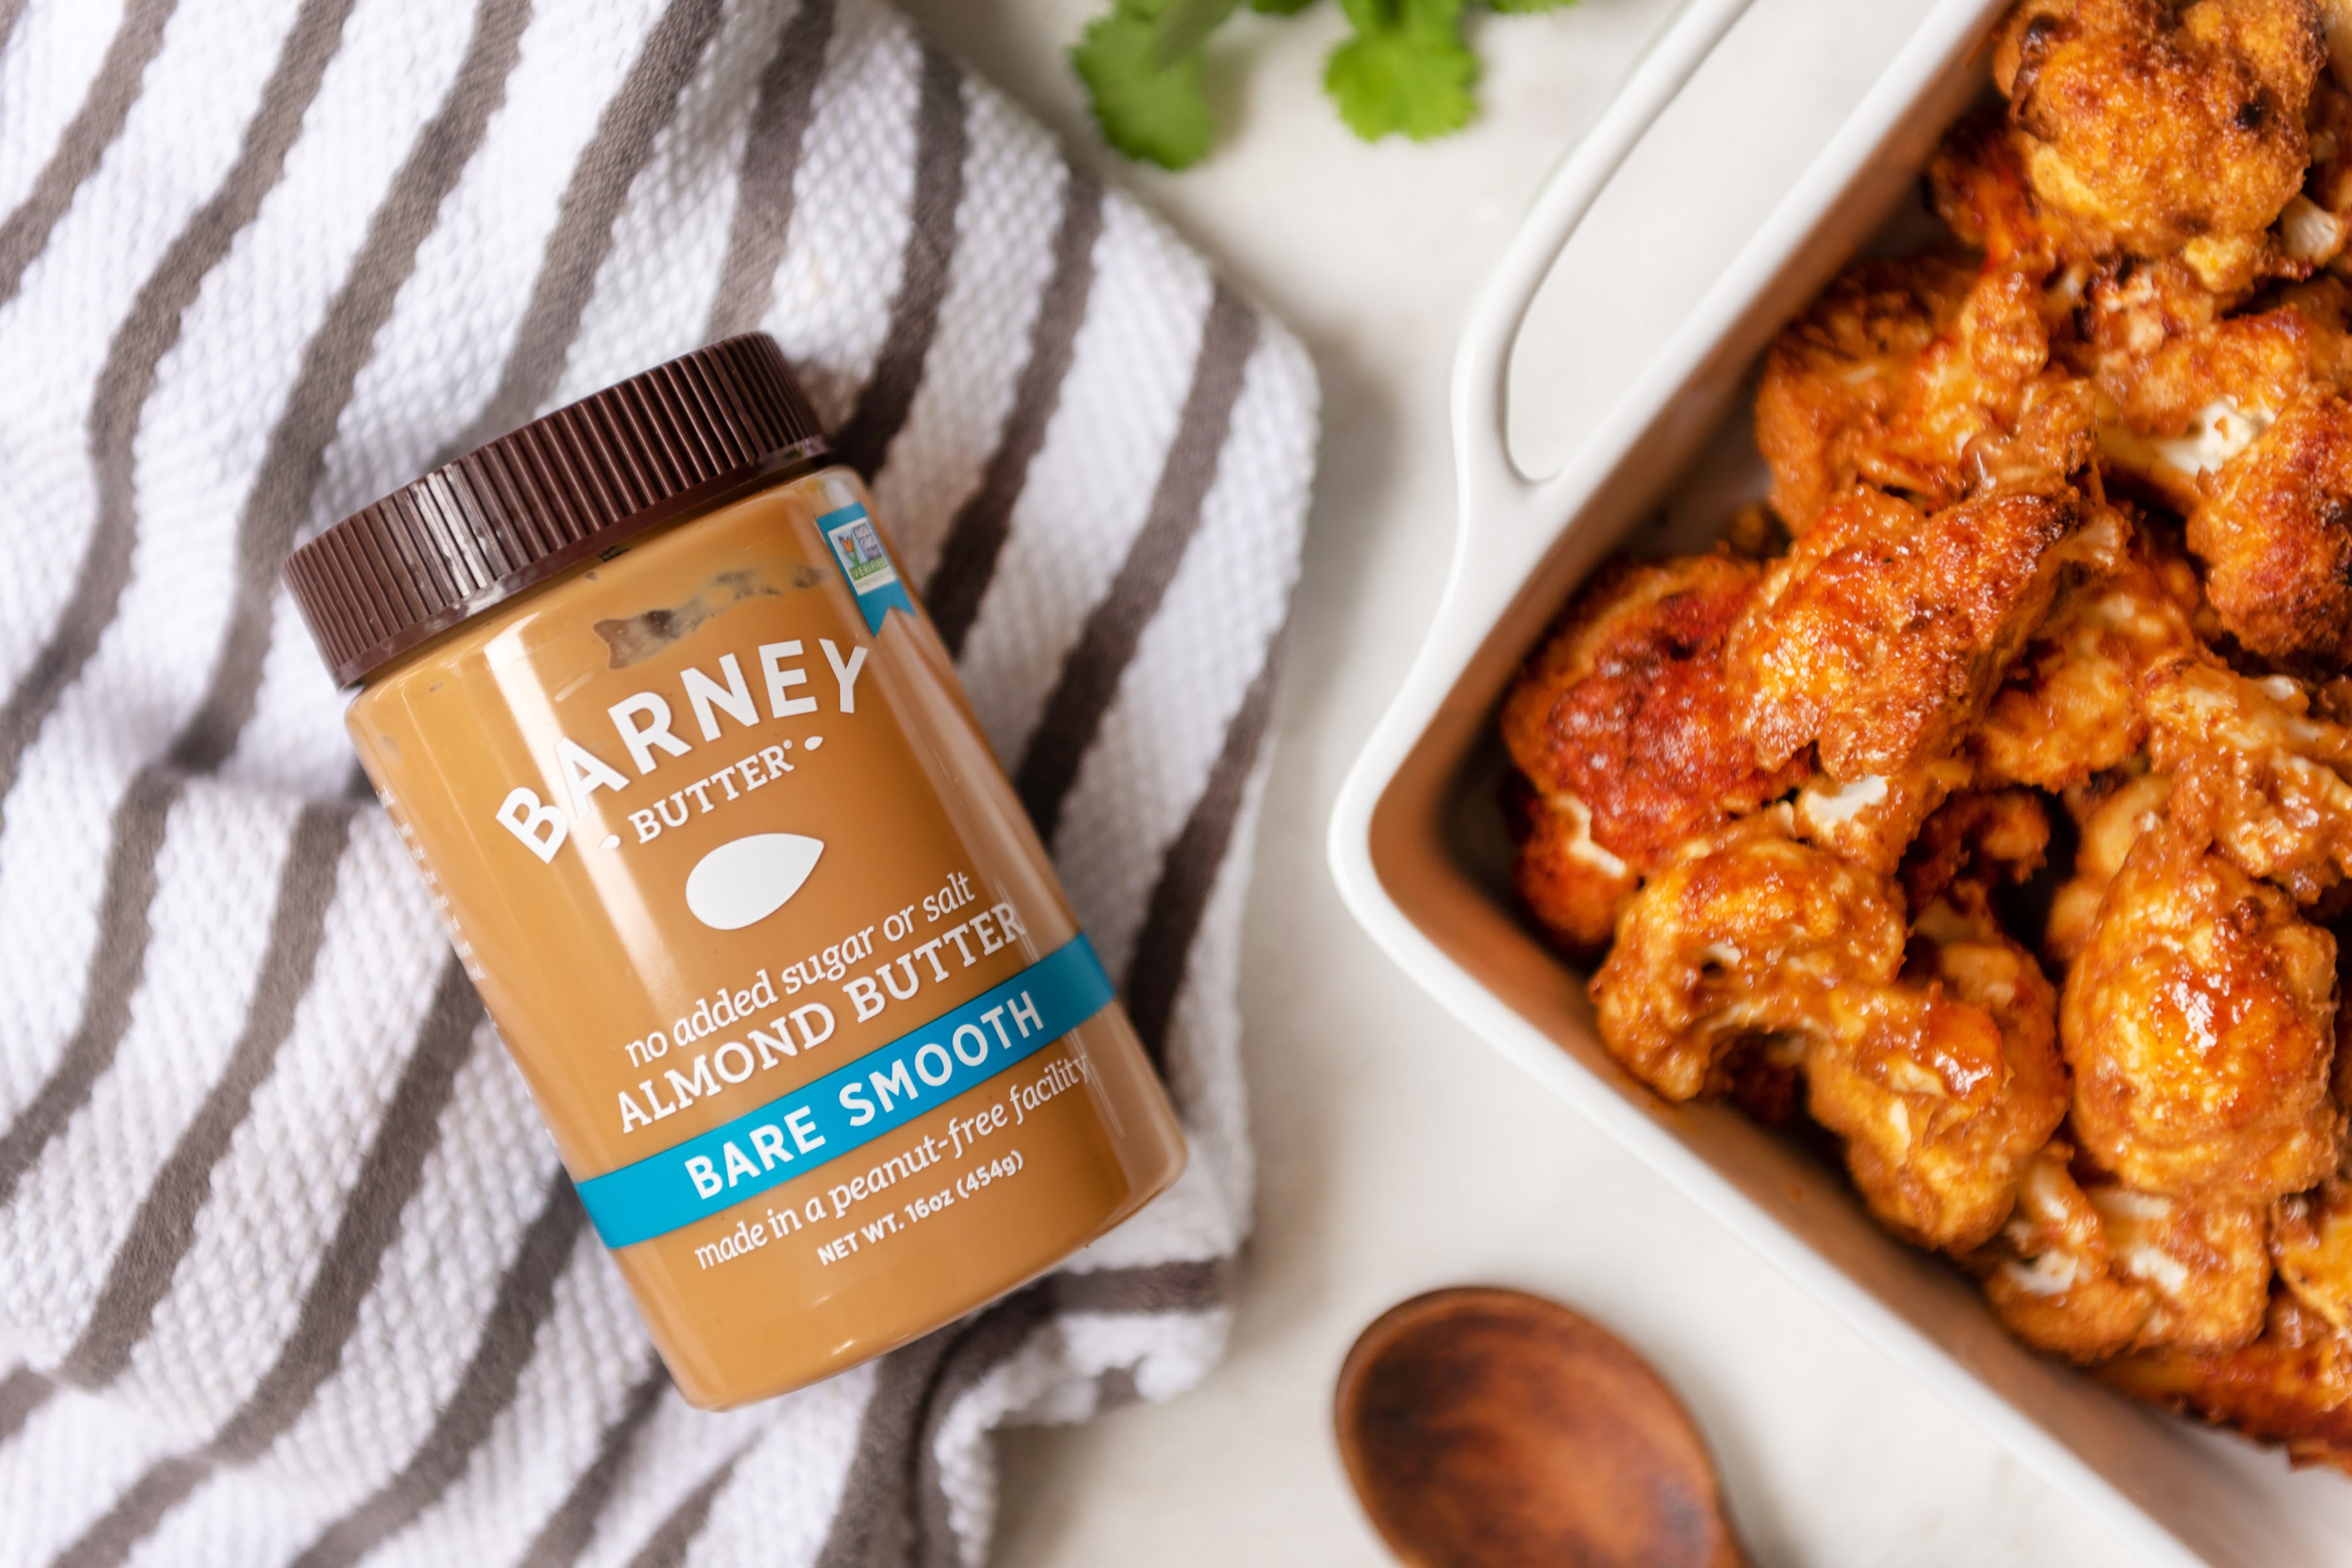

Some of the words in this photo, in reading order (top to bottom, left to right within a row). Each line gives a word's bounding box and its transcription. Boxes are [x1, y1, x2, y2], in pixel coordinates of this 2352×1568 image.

[496, 638, 868, 864] BARNEY
[617, 1002, 835, 1134] ALMOND
[843, 902, 1027, 1023] BUTTER
[624, 1031, 668, 1067] no
[673, 969, 777, 1046] added
[781, 925, 875, 995] sugar
[883, 904, 915, 942] or
[922, 871, 975, 923] salt
[684, 1105, 826, 1200] BARE
[839, 990, 1044, 1126] SMOOTH
[694, 1218, 767, 1270] made
[767, 1208, 802, 1238] in
[805, 1196, 827, 1223] a
[827, 1101, 1008, 1218] peanut-free
[1008, 1055, 1090, 1124] facility
[817, 1232, 859, 1265] NET
[861, 1213, 905, 1245] WT.
[904, 1191, 955, 1223] 16oz
[956, 1149, 1023, 1198] (454g)
